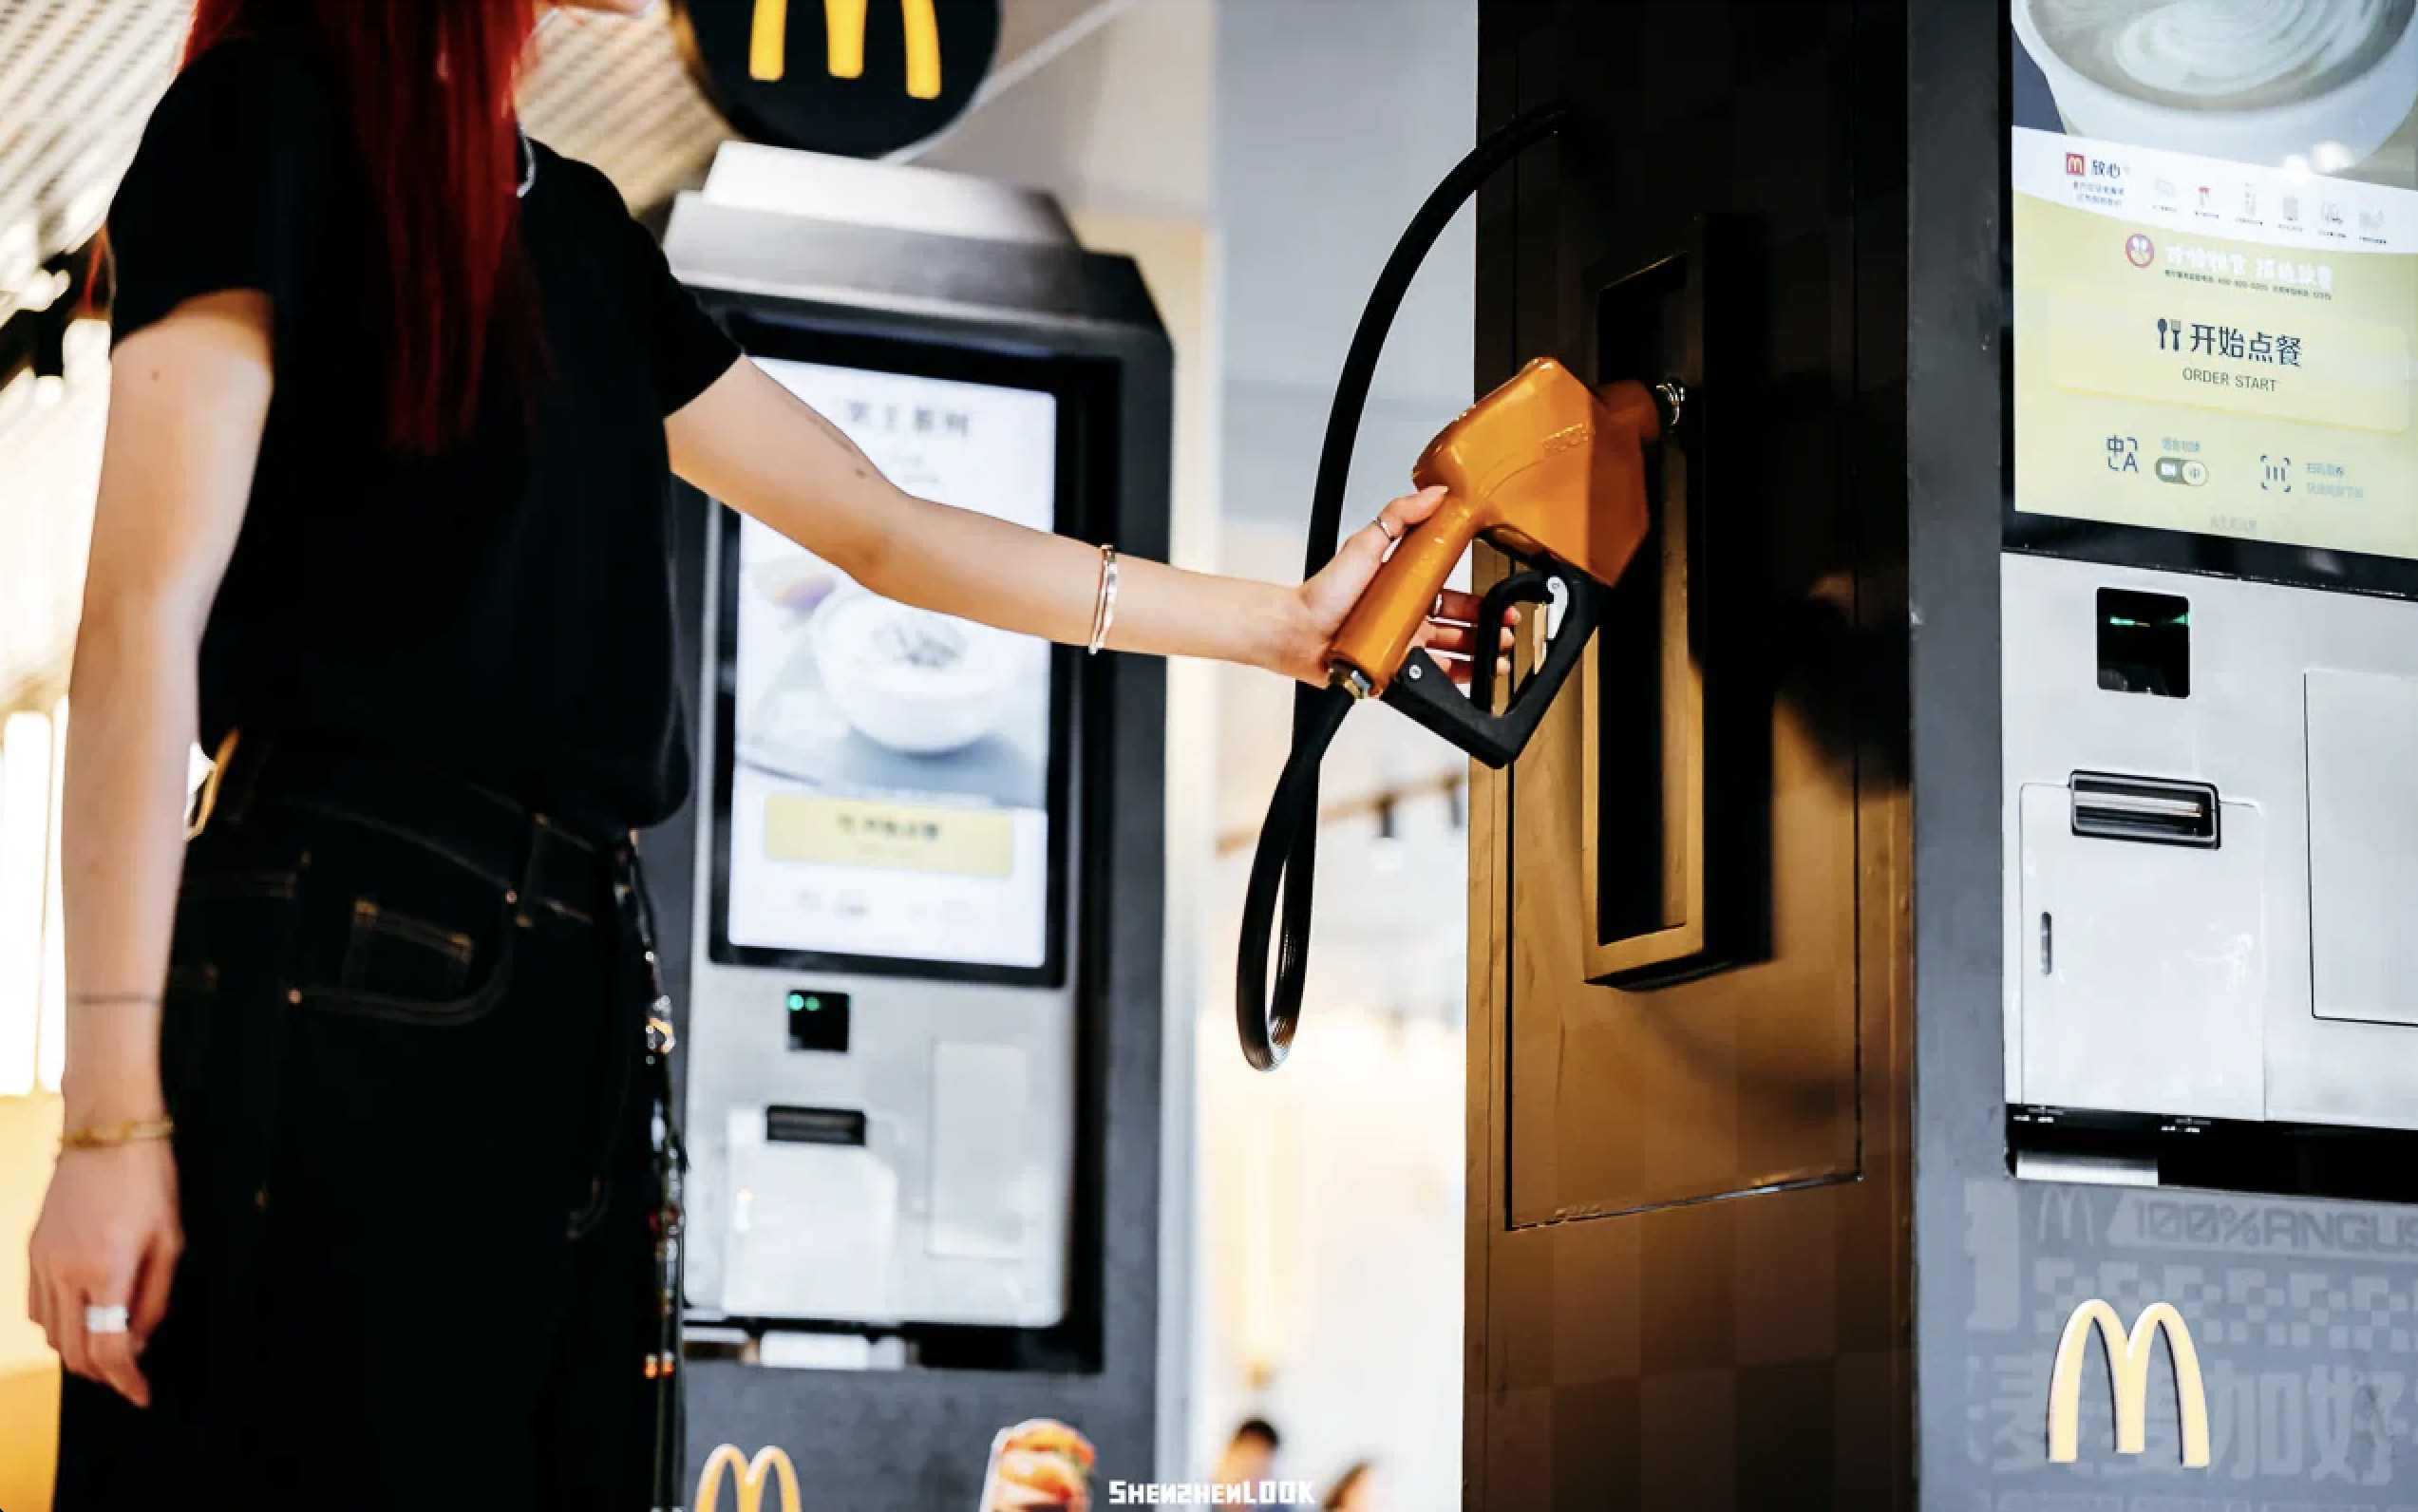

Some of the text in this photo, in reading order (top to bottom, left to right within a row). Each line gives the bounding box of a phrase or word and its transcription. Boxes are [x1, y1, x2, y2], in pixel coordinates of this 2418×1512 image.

[2189, 323, 2302, 368] 开始点餐
[2182, 368, 2276, 391] ORDER START
